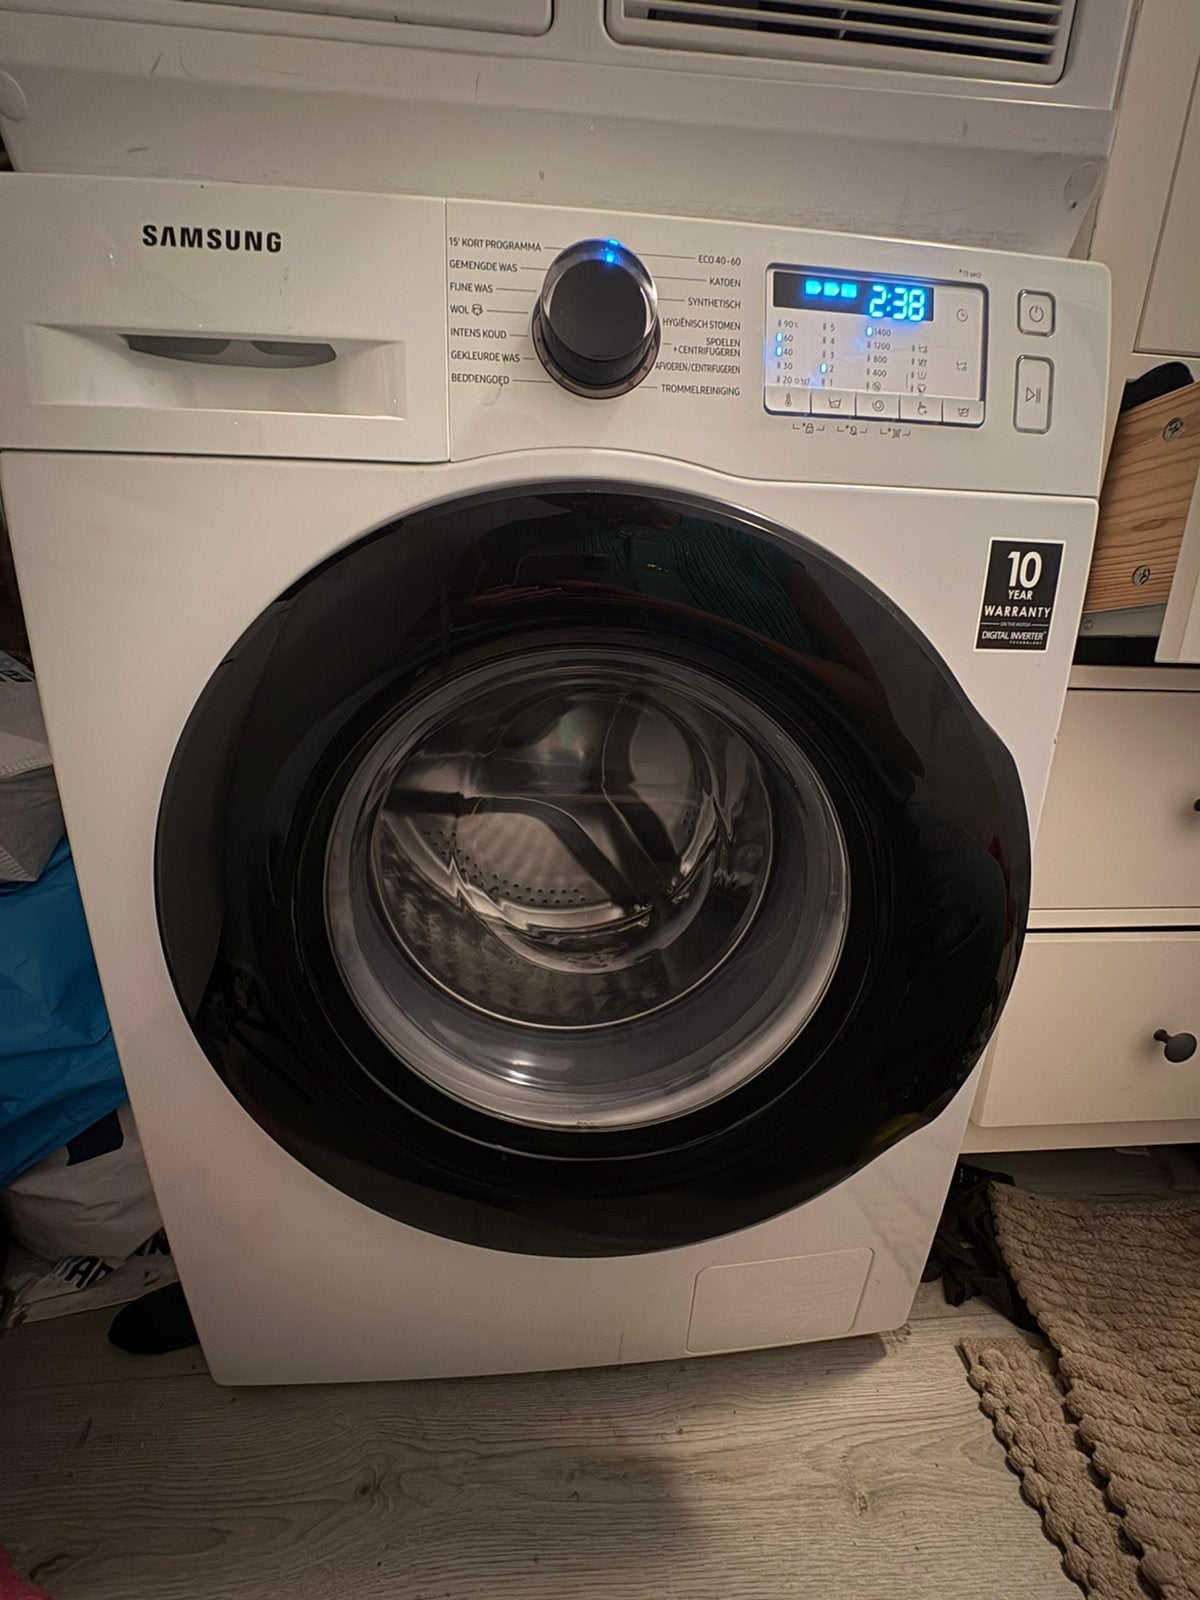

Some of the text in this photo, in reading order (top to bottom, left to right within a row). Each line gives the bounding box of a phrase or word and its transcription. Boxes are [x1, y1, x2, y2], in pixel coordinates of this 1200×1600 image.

[142, 224, 282, 253] SAMSUNG
[462, 238, 484, 248] KORT
[486, 240, 542, 251] PROGRAMMA
[698, 255, 714, 264] ECO
[449, 259, 518, 272] GEMENGDE WAS
[709, 277, 741, 287] KATOEN
[450, 282, 493, 293] FIJNE WAS
[688, 297, 741, 309] SYNTHETISCH
[869, 285, 925, 321] 2:38
[450, 304, 470, 314] WOL
[709, 320, 741, 331] STOMEN
[830, 323, 835, 332] 5
[450, 328, 507, 339] INTENS KOUD
[784, 334, 793, 342] 60
[874, 329, 892, 337] 1400
[706, 337, 740, 347] SPOELEN
[874, 342, 891, 350] 1200
[451, 350, 520, 362] GEKLEURDE WAS
[784, 348, 793, 356] 40
[830, 351, 835, 359] 3
[873, 356, 888, 364] 800
[783, 362, 793, 370] 30
[829, 365, 834, 373] 2
[872, 369, 887, 378] 400
[451, 373, 510, 385] BEDDENGOED
[783, 376, 792, 384] 20
[661, 384, 740, 396] TROMMELREINIGING
[1007, 551, 1042, 588] 10
[1008, 589, 1033, 600] YEAR
[984, 605, 1051, 618] WARRANTY
[982, 630, 1009, 640] DIGITAL
